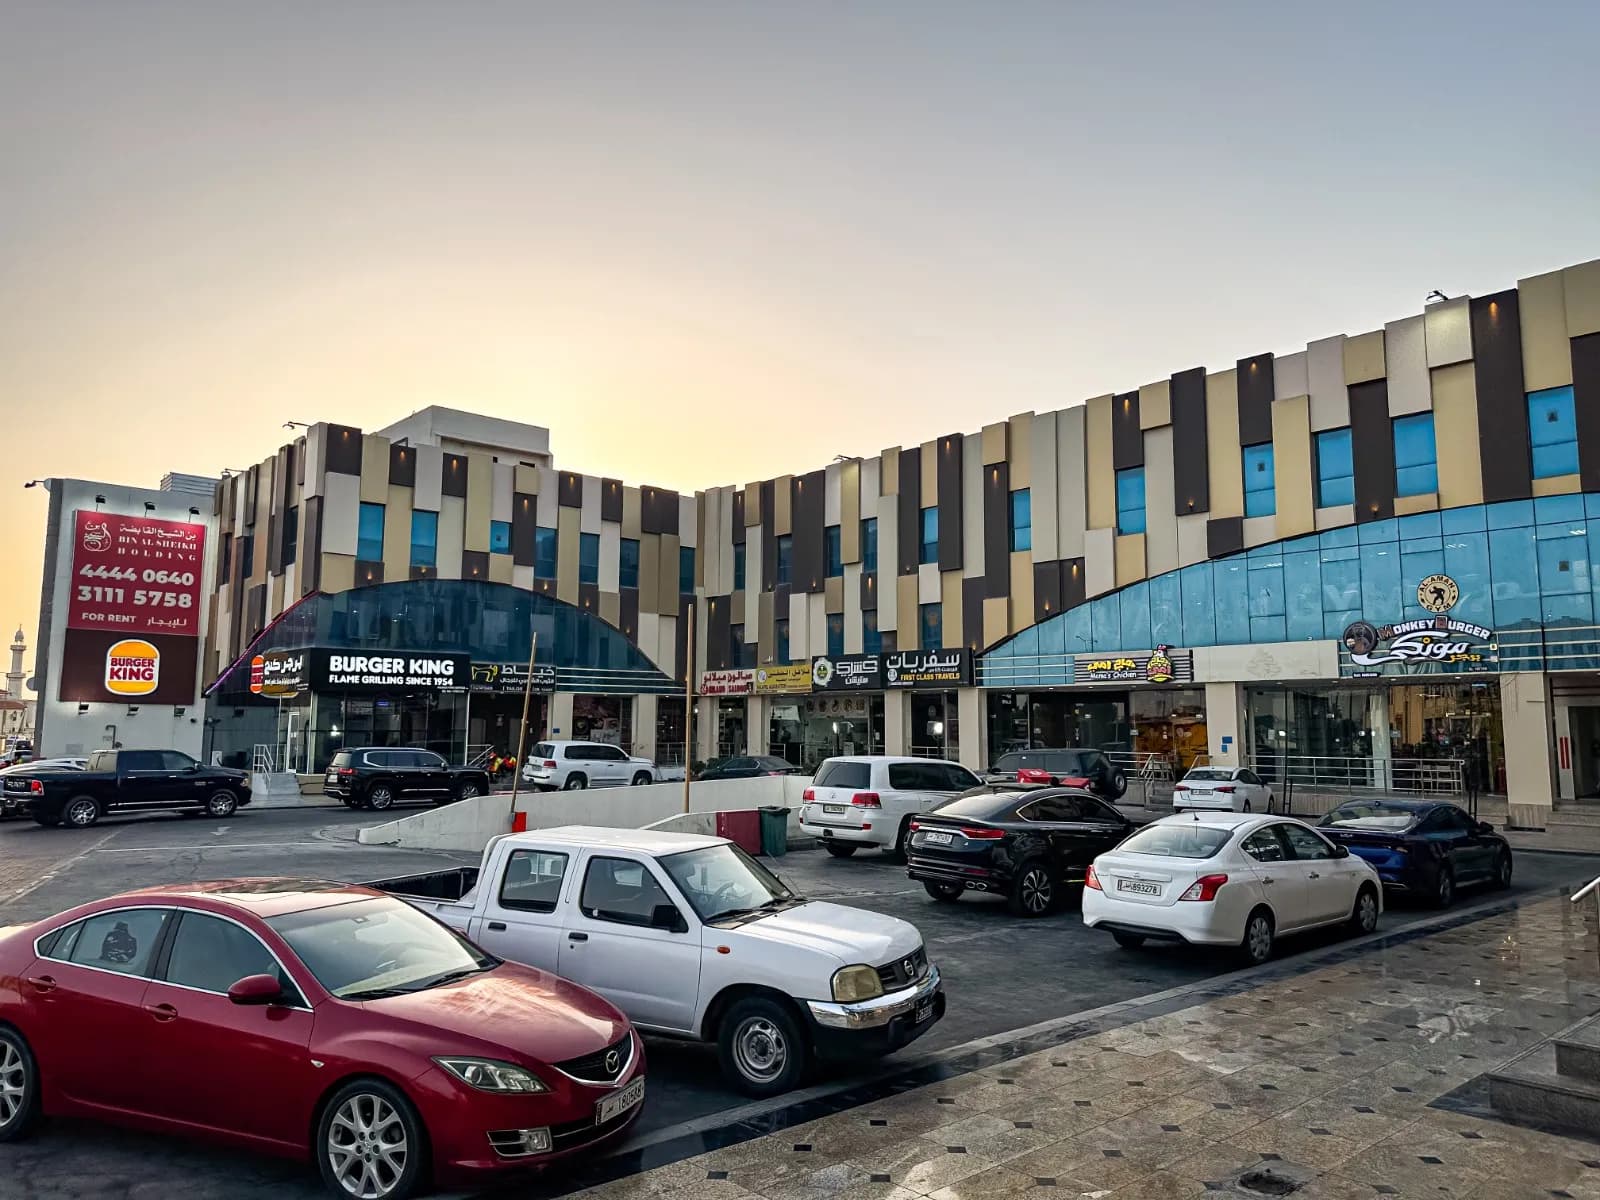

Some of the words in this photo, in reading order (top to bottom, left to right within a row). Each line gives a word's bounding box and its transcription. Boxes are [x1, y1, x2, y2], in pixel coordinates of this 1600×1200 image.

[157, 527, 185, 538] الشيخ
[119, 535, 138, 544] BIN
[142, 537, 154, 546] AL
[156, 539, 197, 550] SHEIKH
[117, 547, 196, 561] HOLDING
[80, 564, 138, 581] 4444
[142, 569, 194, 586] 0640
[78, 585, 125, 603] 3111
[133, 590, 193, 608] 5758
[1426, 603, 1451, 612] GYM
[82, 612, 105, 622] FOR
[108, 614, 137, 623] RENT
[1378, 619, 1435, 640] MONKEY
[111, 657, 155, 668] BURGER
[329, 655, 405, 674] BURGER
[409, 659, 455, 676] KING
[886, 649, 960, 674] سفريات
[110, 667, 154, 681] KING
[329, 674, 360, 684] FLAME
[362, 675, 404, 685] GRILLING
[405, 677, 432, 686] SINCE
[434, 677, 454, 686] 1954
[900, 673, 915, 681] FIRST
[916, 673, 934, 681] CLASS
[935, 672, 960, 680] TRAVELS
